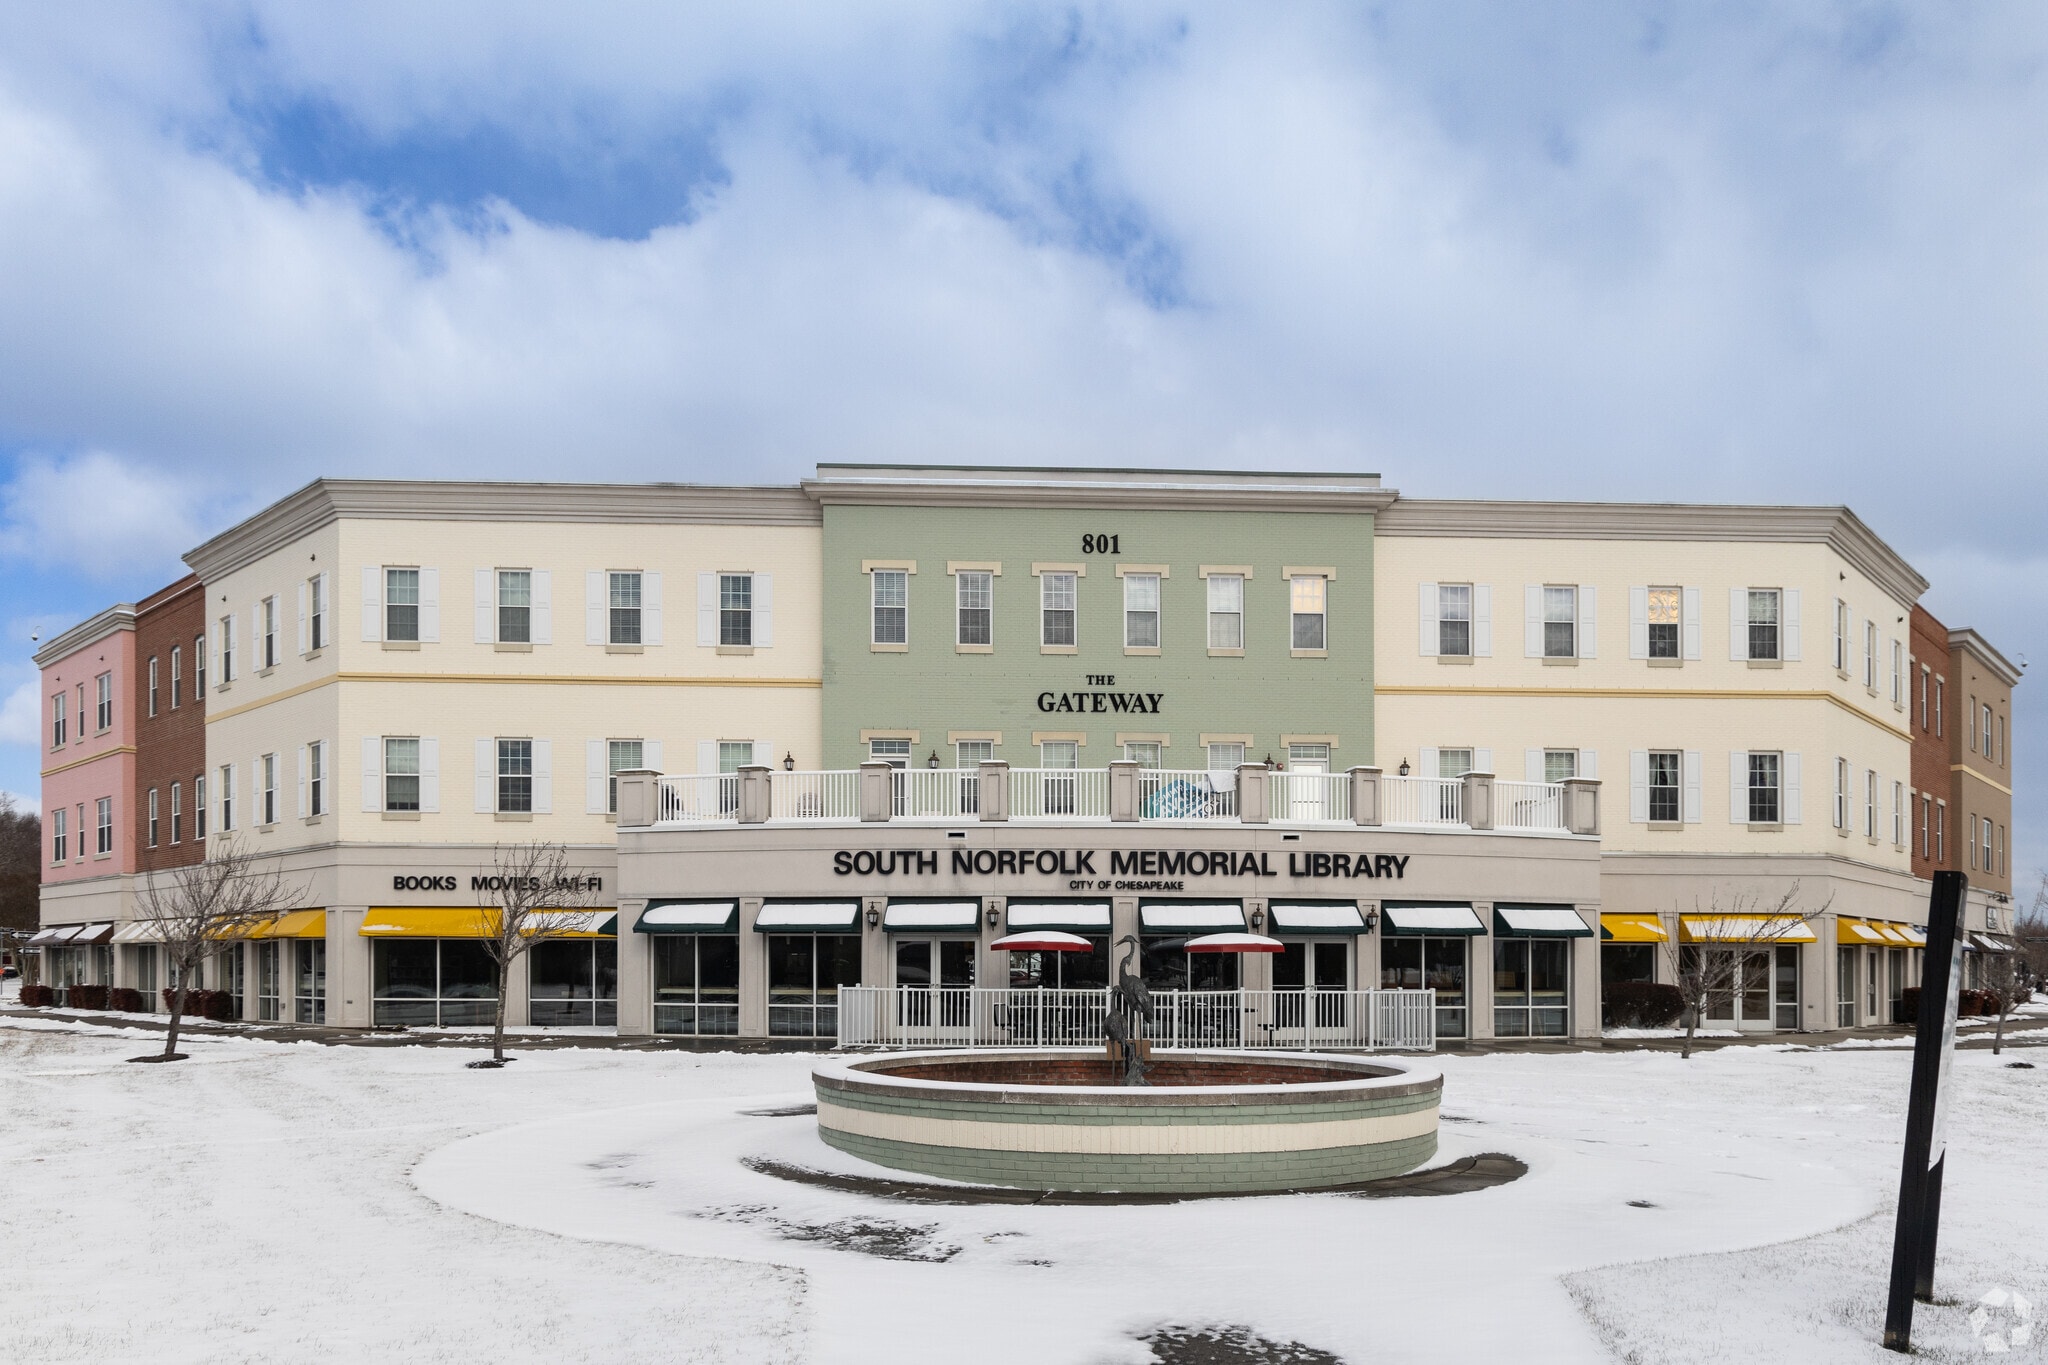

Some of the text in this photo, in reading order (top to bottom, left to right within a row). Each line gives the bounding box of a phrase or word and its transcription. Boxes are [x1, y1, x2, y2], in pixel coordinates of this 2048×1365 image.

[1081, 533, 1121, 555] 801
[1085, 674, 1116, 686] THE
[1036, 691, 1164, 714] GATEWAY
[833, 848, 1411, 880] SOUTH NORFOLK MEMORIAL LIBRARY
[393, 875, 457, 891] BOOKS
[470, 875, 541, 892] MOVIES
[1069, 880, 1185, 892] CITY OF CHESAPEAKE
